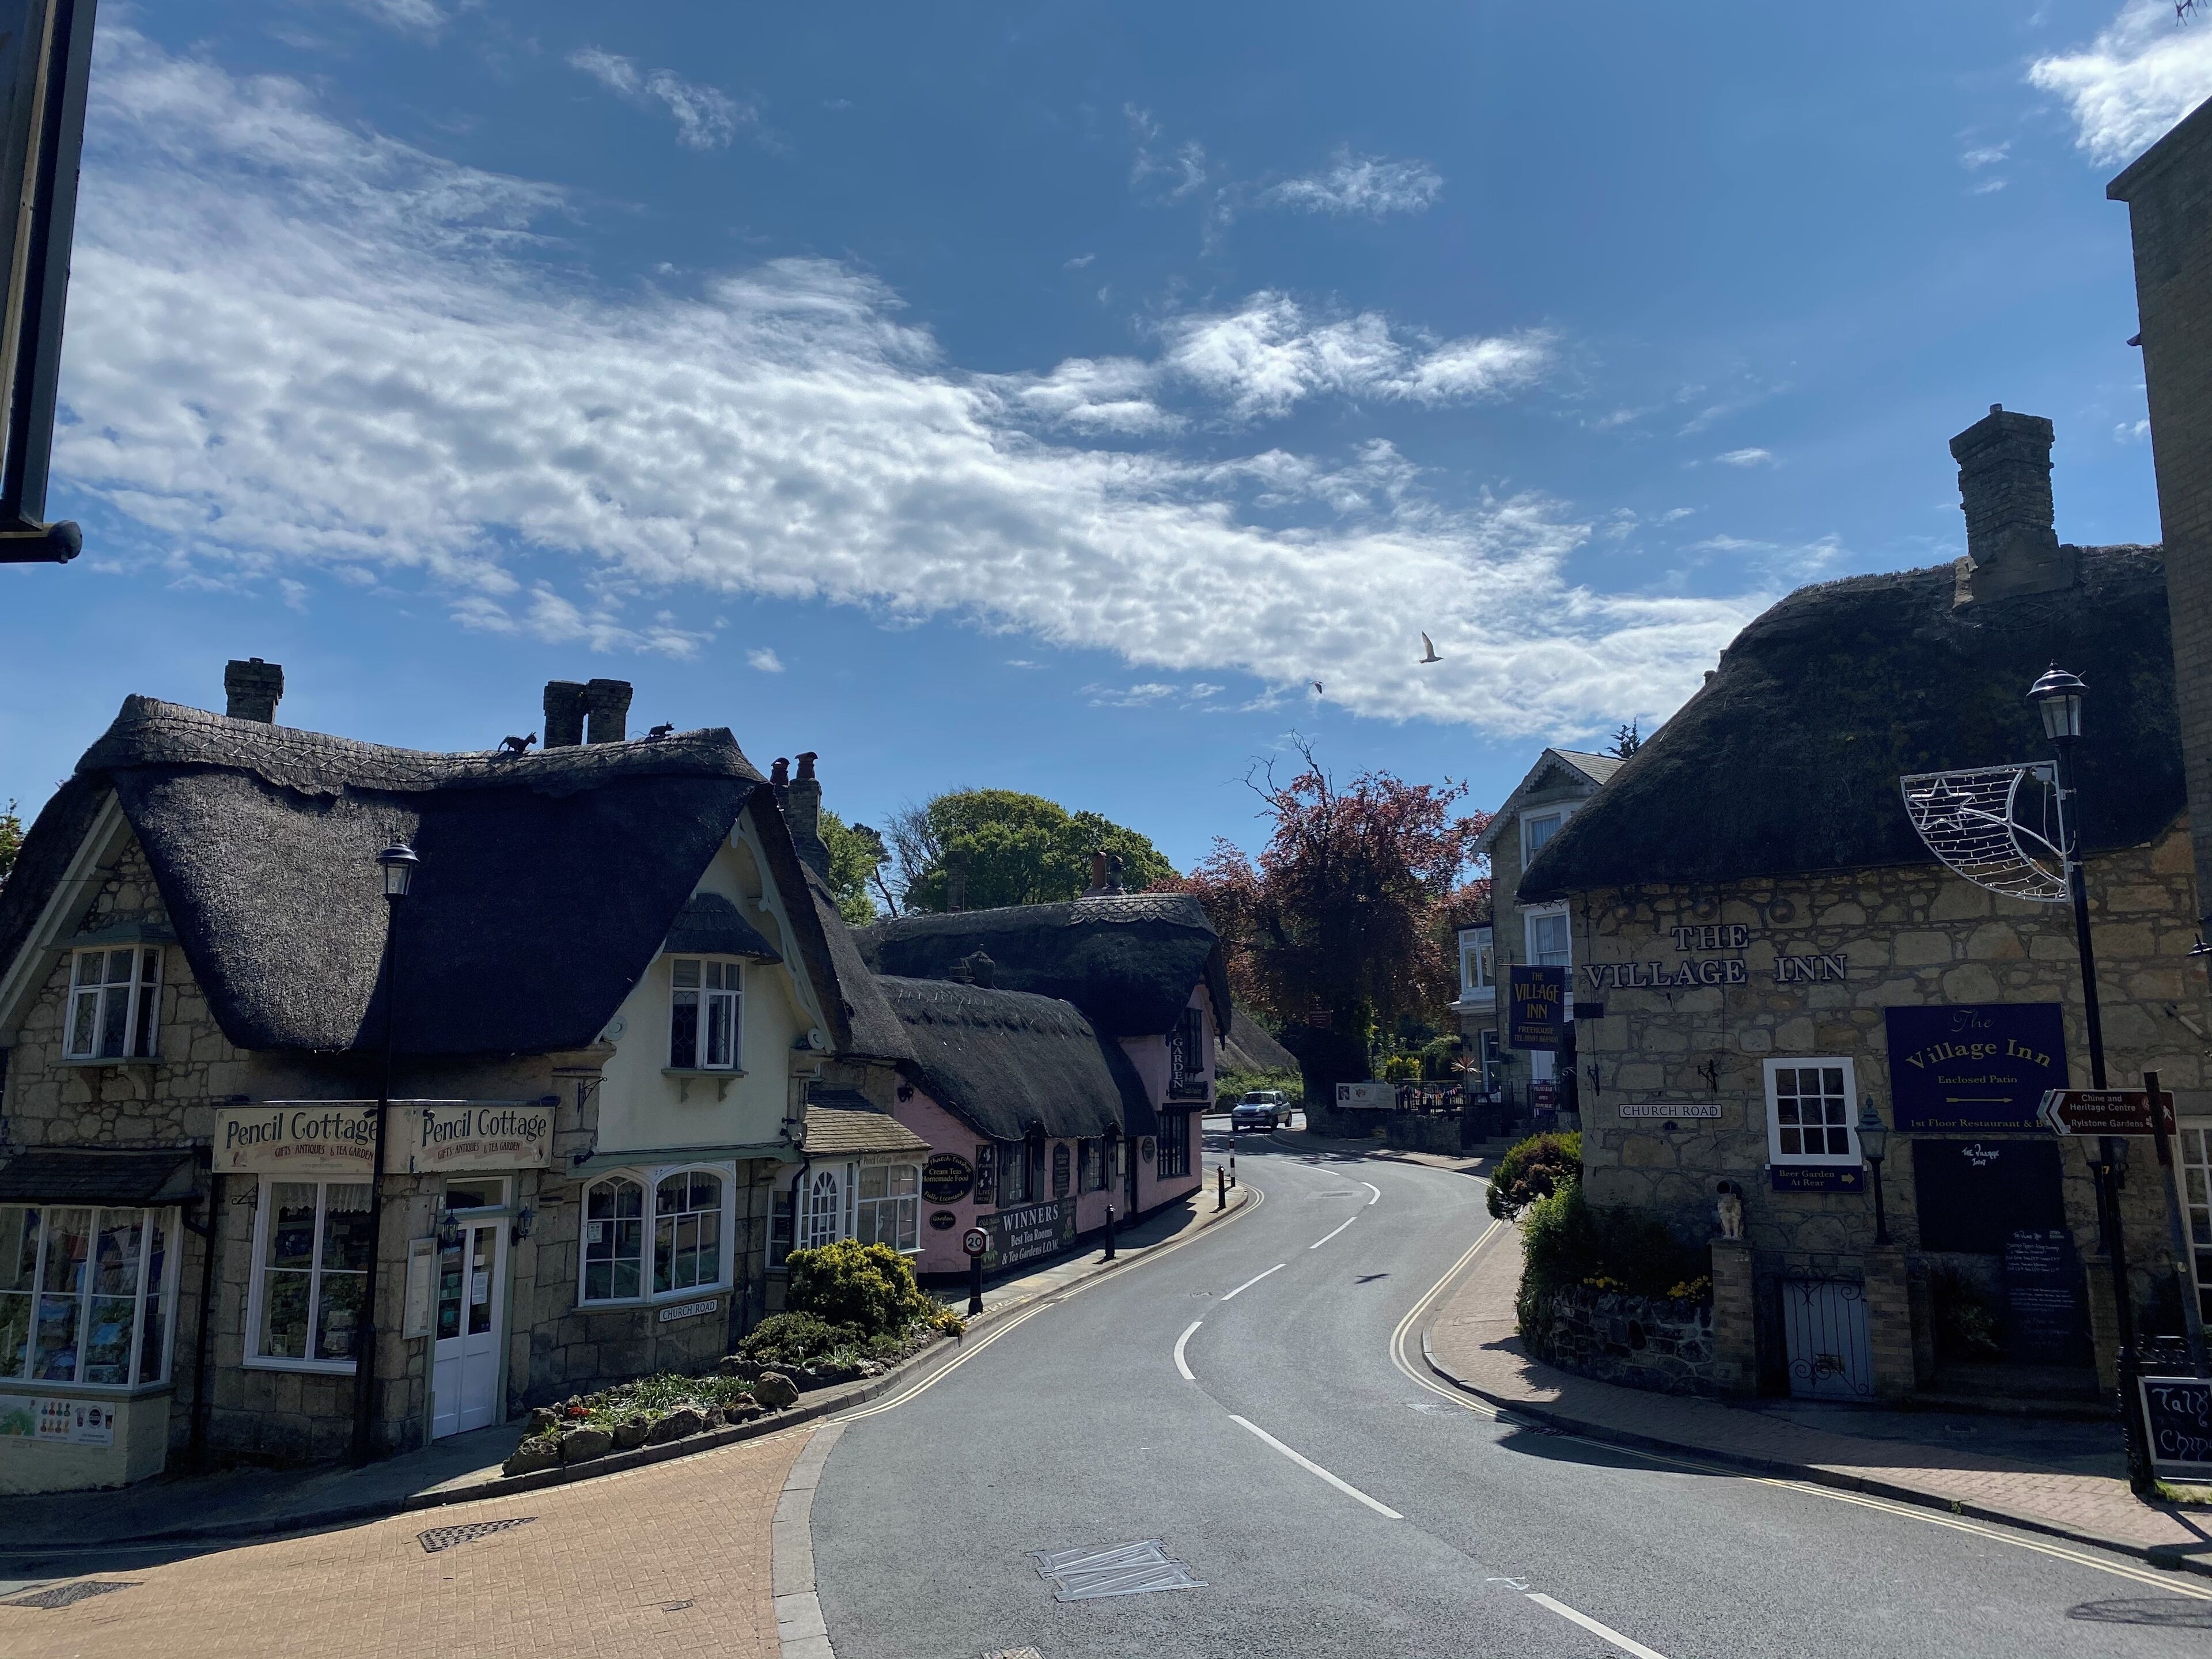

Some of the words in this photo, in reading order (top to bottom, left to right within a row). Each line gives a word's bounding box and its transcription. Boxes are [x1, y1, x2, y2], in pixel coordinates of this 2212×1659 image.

[1671, 923, 1749, 950] THE
[1531, 972, 1544, 981] THE
[1582, 959, 1747, 989] VILLAGE
[1774, 954, 1847, 983] INN
[1514, 983, 1560, 1004] VILLAGE
[1527, 1003, 1548, 1019] INN
[1950, 1009, 1995, 1032] The
[1518, 1025, 1554, 1035] FREEHOUSE
[1904, 1040, 1998, 1069] Village
[2005, 1038, 2051, 1068] Inn
[1172, 1037, 1184, 1088] GARDEN
[1937, 1074, 1987, 1084] Enclosed
[1989, 1074, 2018, 1084] Patio
[2081, 1094, 2105, 1103] Chine
[2107, 1094, 2123, 1103] and
[1623, 1106, 1677, 1116] CHURCH
[1683, 1106, 1718, 1116] ROAD
[2070, 1103, 2105, 1112] Heritage
[2108, 1103, 2136, 1112] Centre
[226, 1112, 283, 1149] Pencil
[422, 1110, 471, 1147] Pencil
[478, 1109, 547, 1142] Cottage
[1911, 1119, 1926, 1127] 1st
[1928, 1119, 1957, 1127] Floor
[1959, 1119, 2020, 1128] Restaurant
[2023, 1119, 2032, 1128] &
[2071, 1119, 2108, 1128] Rylstone
[2109, 1119, 2144, 1128] Gardens
[275, 1145, 291, 1158] GIFTS
[295, 1143, 325, 1155] ANTIQUES
[336, 1145, 347, 1156] TEA
[349, 1146, 374, 1161] GARDEN
[437, 1147, 452, 1160] GIFTS
[455, 1142, 479, 1153] ANTIQUES
[489, 1143, 498, 1152] TEA
[500, 1142, 520, 1151] GARDEN
[930, 1156, 952, 1165] Thatch
[953, 1157, 971, 1173] Teashop
[1779, 1169, 1800, 1177] Beer
[1801, 1170, 1835, 1178] Garden
[1803, 1179, 1825, 1187] Rear
[923, 1190, 938, 1201] Fully
[939, 1190, 964, 1202] Licensed
[1002, 1203, 1059, 1232] WINNERS
[968, 1237, 982, 1247] 20
[1010, 1234, 1023, 1247] Best
[1023, 1231, 1033, 1244] Tea
[1034, 1228, 1053, 1241] Rooms
[1001, 1252, 1007, 1265] &
[1009, 1250, 1018, 1263] Tea
[1019, 1245, 1042, 1260] Gardens
[663, 1305, 692, 1320] CHURCH
[695, 1301, 715, 1313] ROAD
